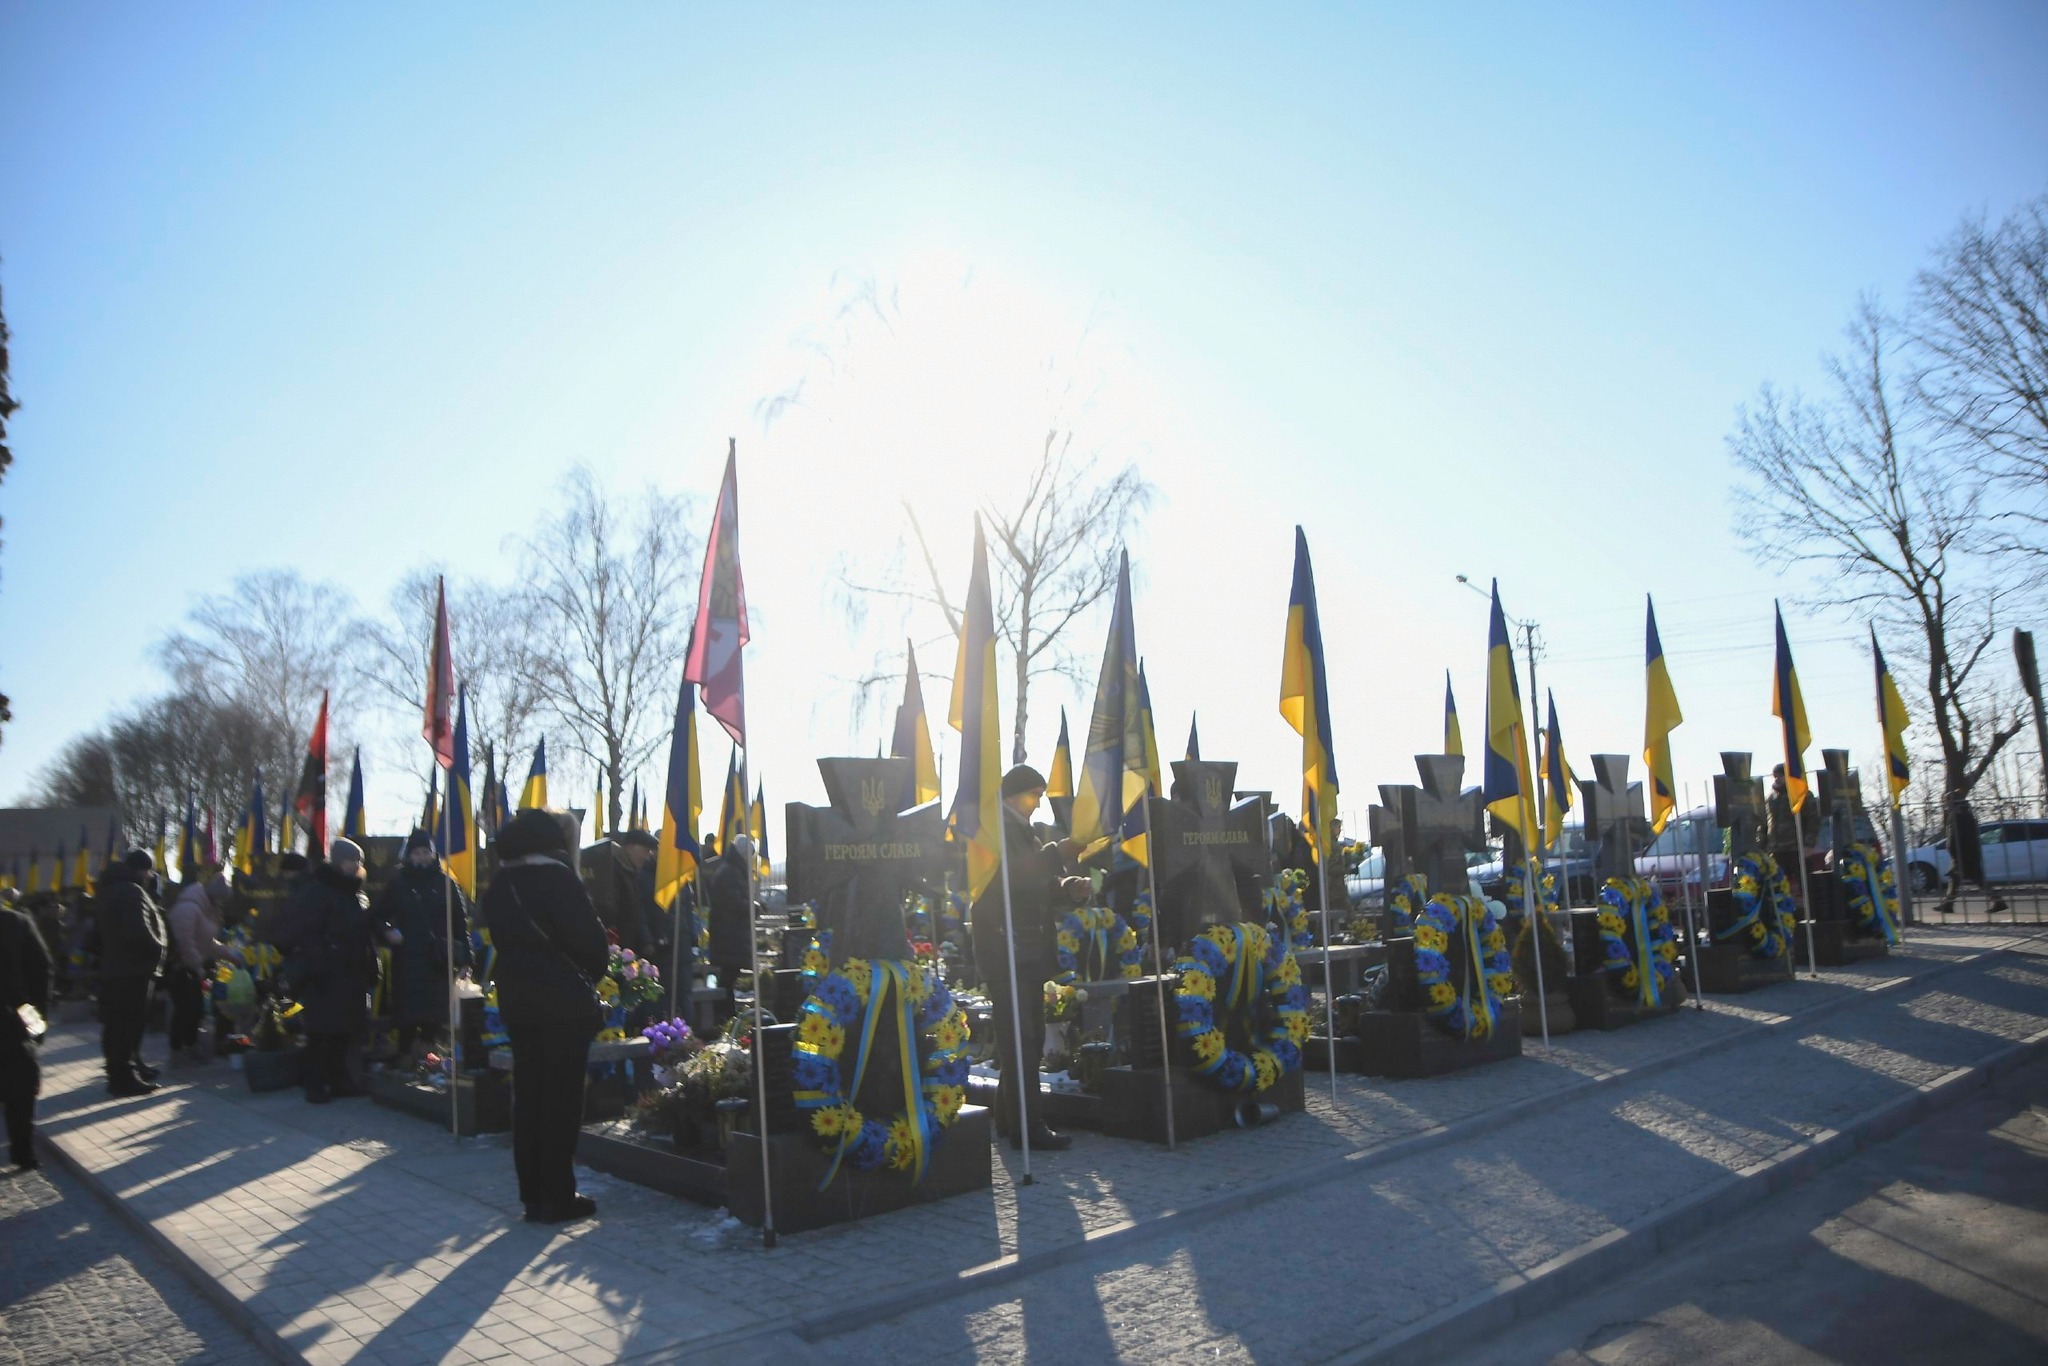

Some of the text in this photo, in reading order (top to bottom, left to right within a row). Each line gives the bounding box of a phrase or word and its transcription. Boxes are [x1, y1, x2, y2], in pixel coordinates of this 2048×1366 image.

[1183, 830, 1249, 845] ГЕРОЯМ СЛАВА
[824, 843, 921, 860] ГЕРОЯМ СЛАВА
